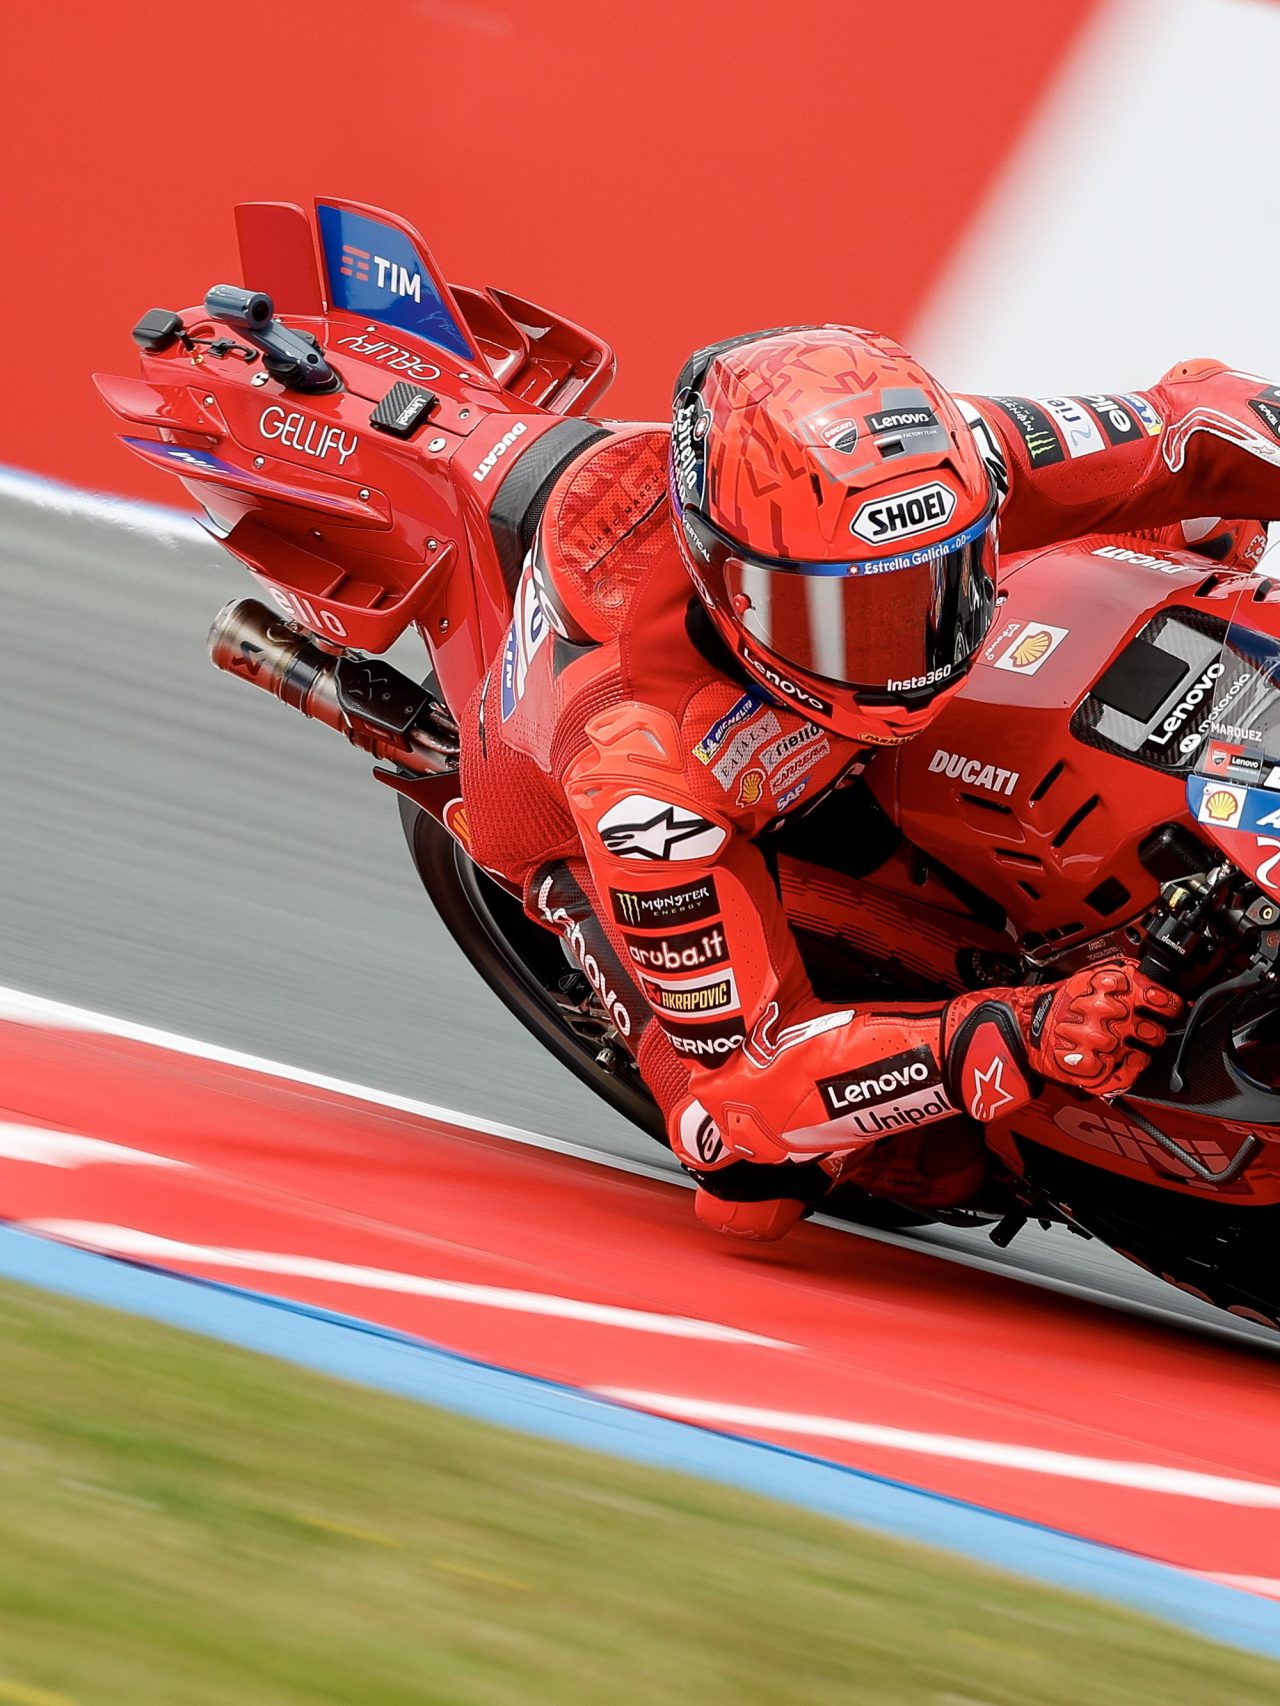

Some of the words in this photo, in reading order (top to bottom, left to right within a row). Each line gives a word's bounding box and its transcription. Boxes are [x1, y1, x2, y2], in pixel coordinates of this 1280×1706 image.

[374, 255, 421, 304] TIM
[337, 334, 441, 380] GELLIFY
[397, 395, 427, 426] Unipol
[824, 420, 853, 438] DUCATI
[871, 412, 930, 430] Lenovo
[259, 406, 358, 465] GELLIFY
[472, 421, 528, 482] DUCATI
[624, 467, 667, 514] MARQUE
[867, 491, 946, 536] SHOEI
[864, 558, 911, 575] Estrella
[912, 543, 950, 566] Galicia
[1091, 546, 1190, 575] DUCATI
[743, 647, 824, 710] Lenovo
[887, 663, 952, 692] Insta360
[714, 699, 753, 741] MICHELIN
[1147, 662, 1226, 746] Lenovo
[1198, 672, 1251, 733] motorola
[722, 724, 770, 779] EATALY
[1210, 721, 1264, 743] MARQUEZ
[772, 743, 828, 788] CARRERA
[928, 749, 1020, 796] DUCATI
[1231, 756, 1260, 769] Lenovo
[777, 782, 806, 811] SAP
[641, 886, 710, 911] MONSTER
[653, 901, 702, 917] ENERGY
[629, 929, 724, 969] aruba.it
[827, 1062, 929, 1109] Lenovo
[853, 1090, 952, 1137] Unipol
